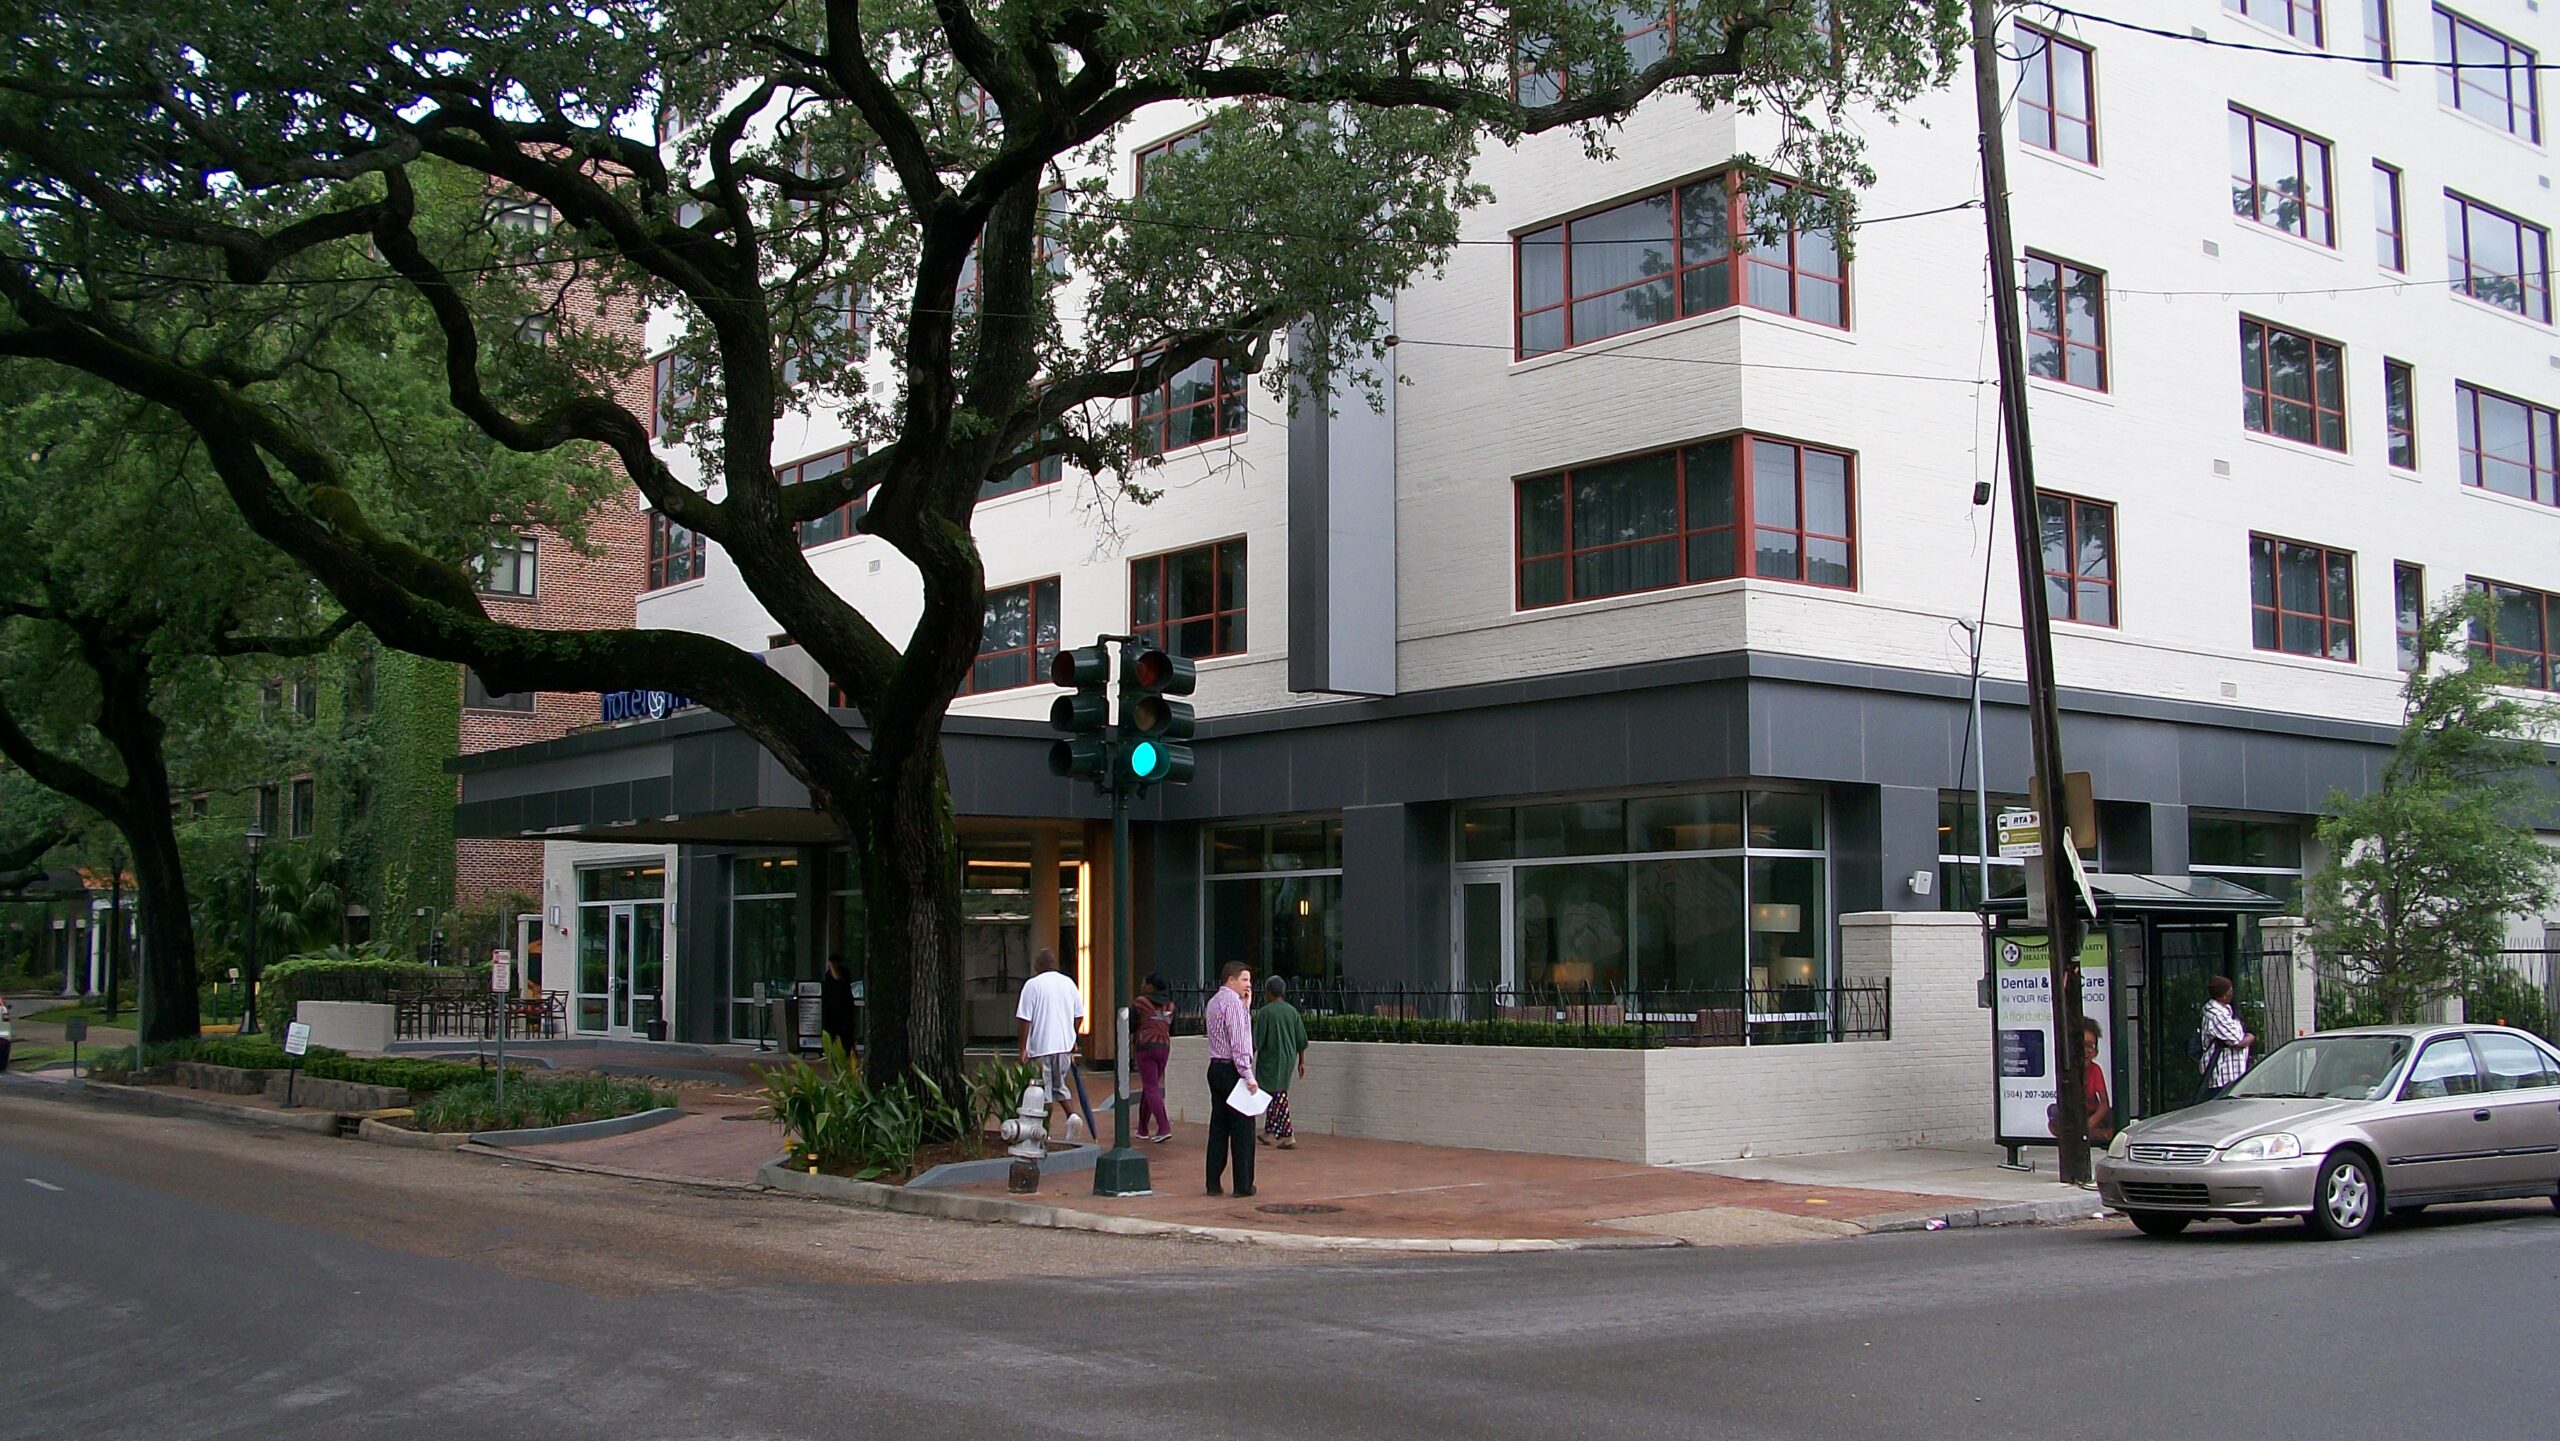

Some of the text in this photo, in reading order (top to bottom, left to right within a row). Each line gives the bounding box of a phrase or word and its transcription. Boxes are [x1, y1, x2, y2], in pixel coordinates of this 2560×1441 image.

[2013, 816, 2028, 824] RTA
[2001, 977, 2038, 989] Dental
[2041, 976, 2049, 988] &
[2002, 994, 2009, 1003] IN
[2013, 994, 2035, 1003] YOUR
[2002, 1010, 2052, 1022] Affordable
[2003, 1090, 2023, 1099] (504)
